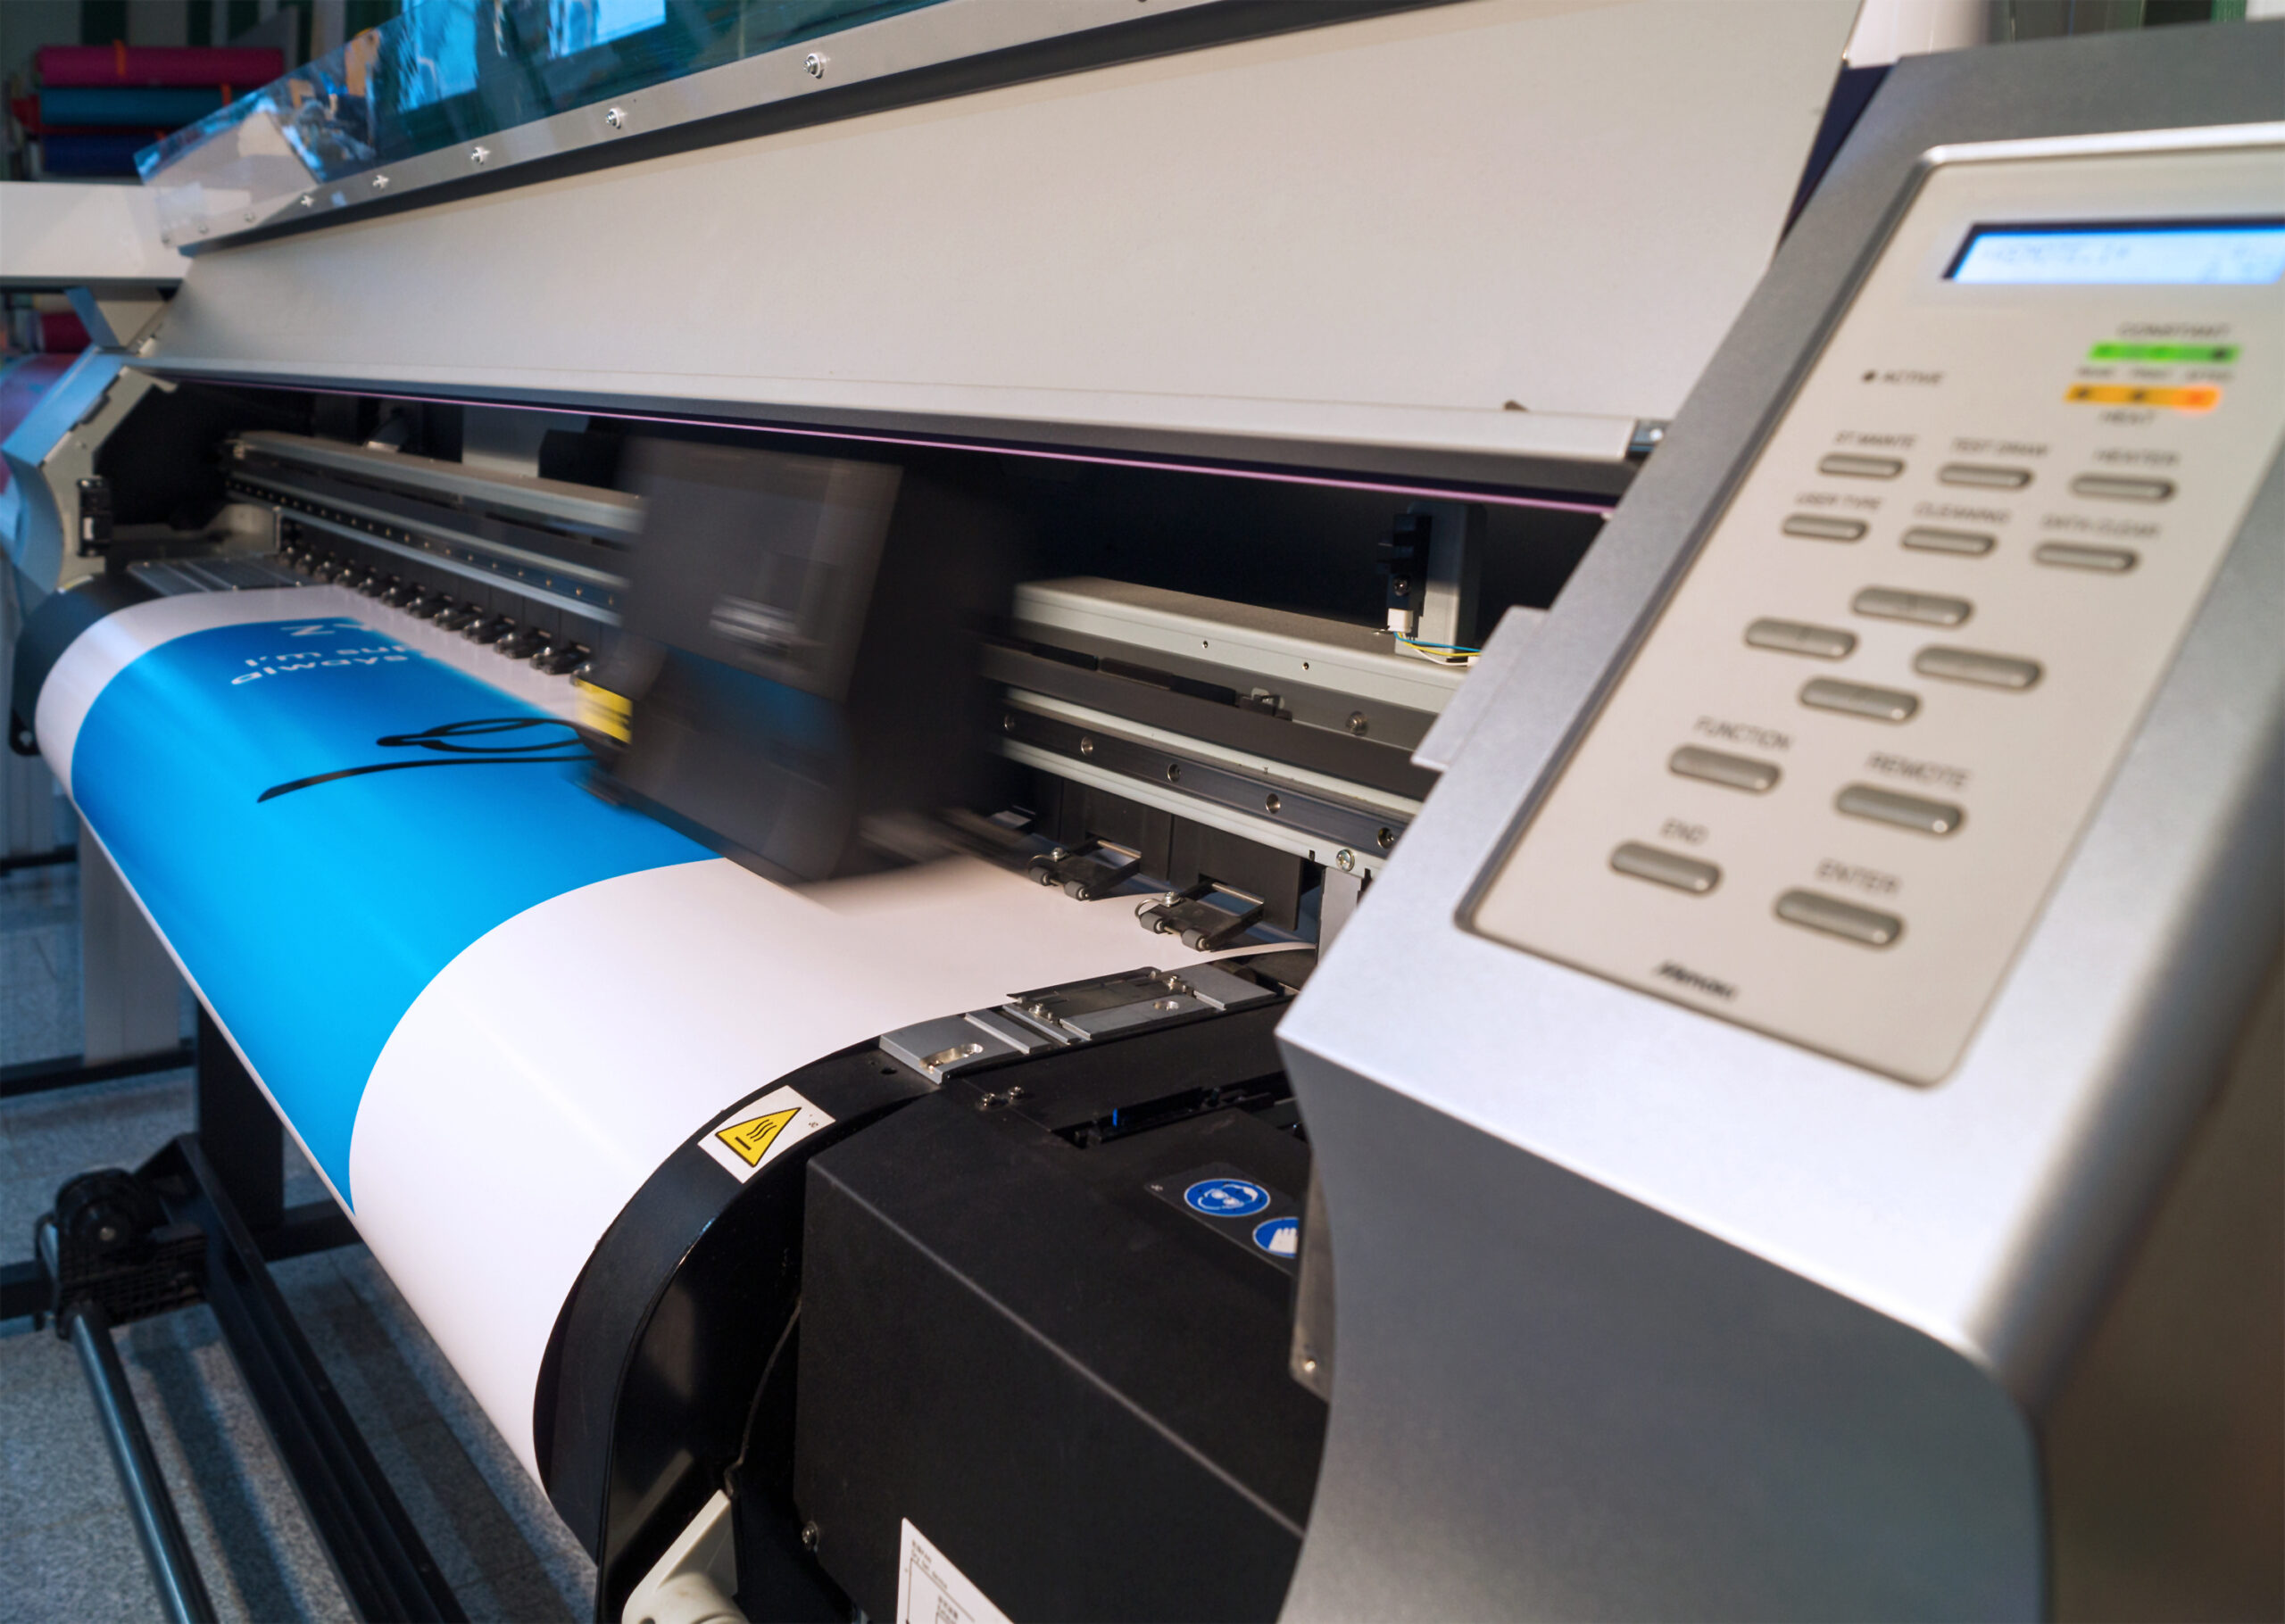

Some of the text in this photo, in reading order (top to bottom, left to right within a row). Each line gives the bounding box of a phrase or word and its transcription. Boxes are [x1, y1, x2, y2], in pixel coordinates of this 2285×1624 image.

[1882, 370, 1944, 386] ACTIVE
[230, 655, 409, 685] always
[1694, 716, 1794, 750] FUNCTION
[1867, 751, 1969, 788] REMOTE
[1661, 817, 1708, 843] END
[1817, 858, 1899, 896] ENTER
